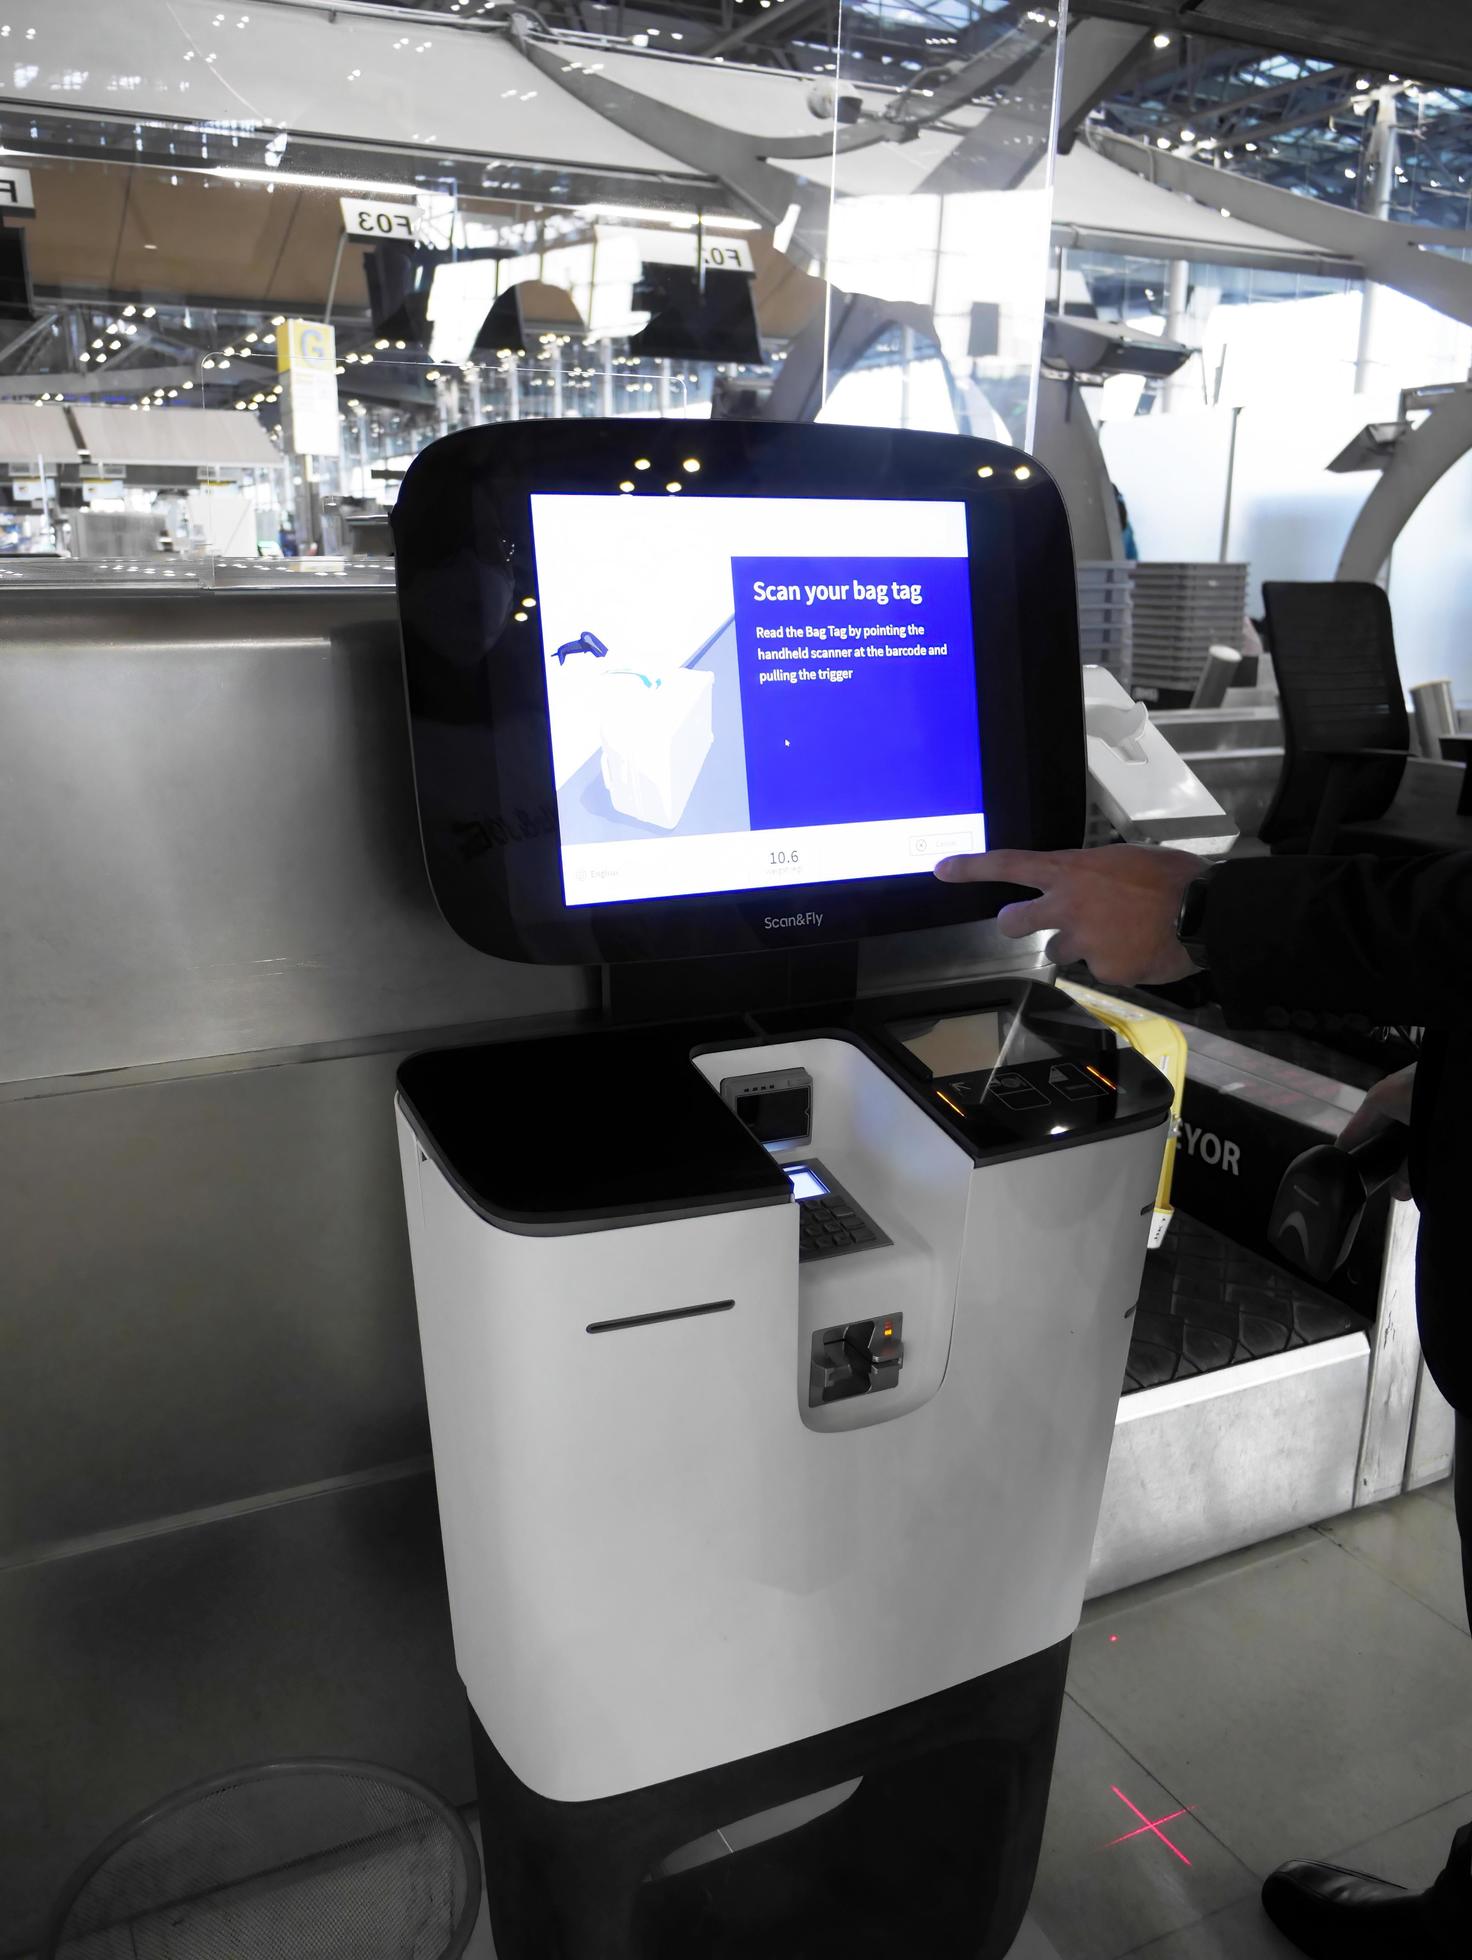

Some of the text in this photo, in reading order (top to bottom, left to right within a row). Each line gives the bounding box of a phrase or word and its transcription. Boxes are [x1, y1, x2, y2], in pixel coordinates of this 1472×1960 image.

[300, 329, 324, 369] G
[753, 580, 923, 606] Scan your bag tag
[755, 624, 925, 640] Read the Bag Tag by pointing the
[757, 644, 948, 661] handheld scanner at the barcode and
[759, 667, 854, 685] pulling the trigger
[770, 850, 799, 865] 10.6
[764, 912, 824, 929] Scan&Fly
[1178, 1118, 1241, 1177] YOR
